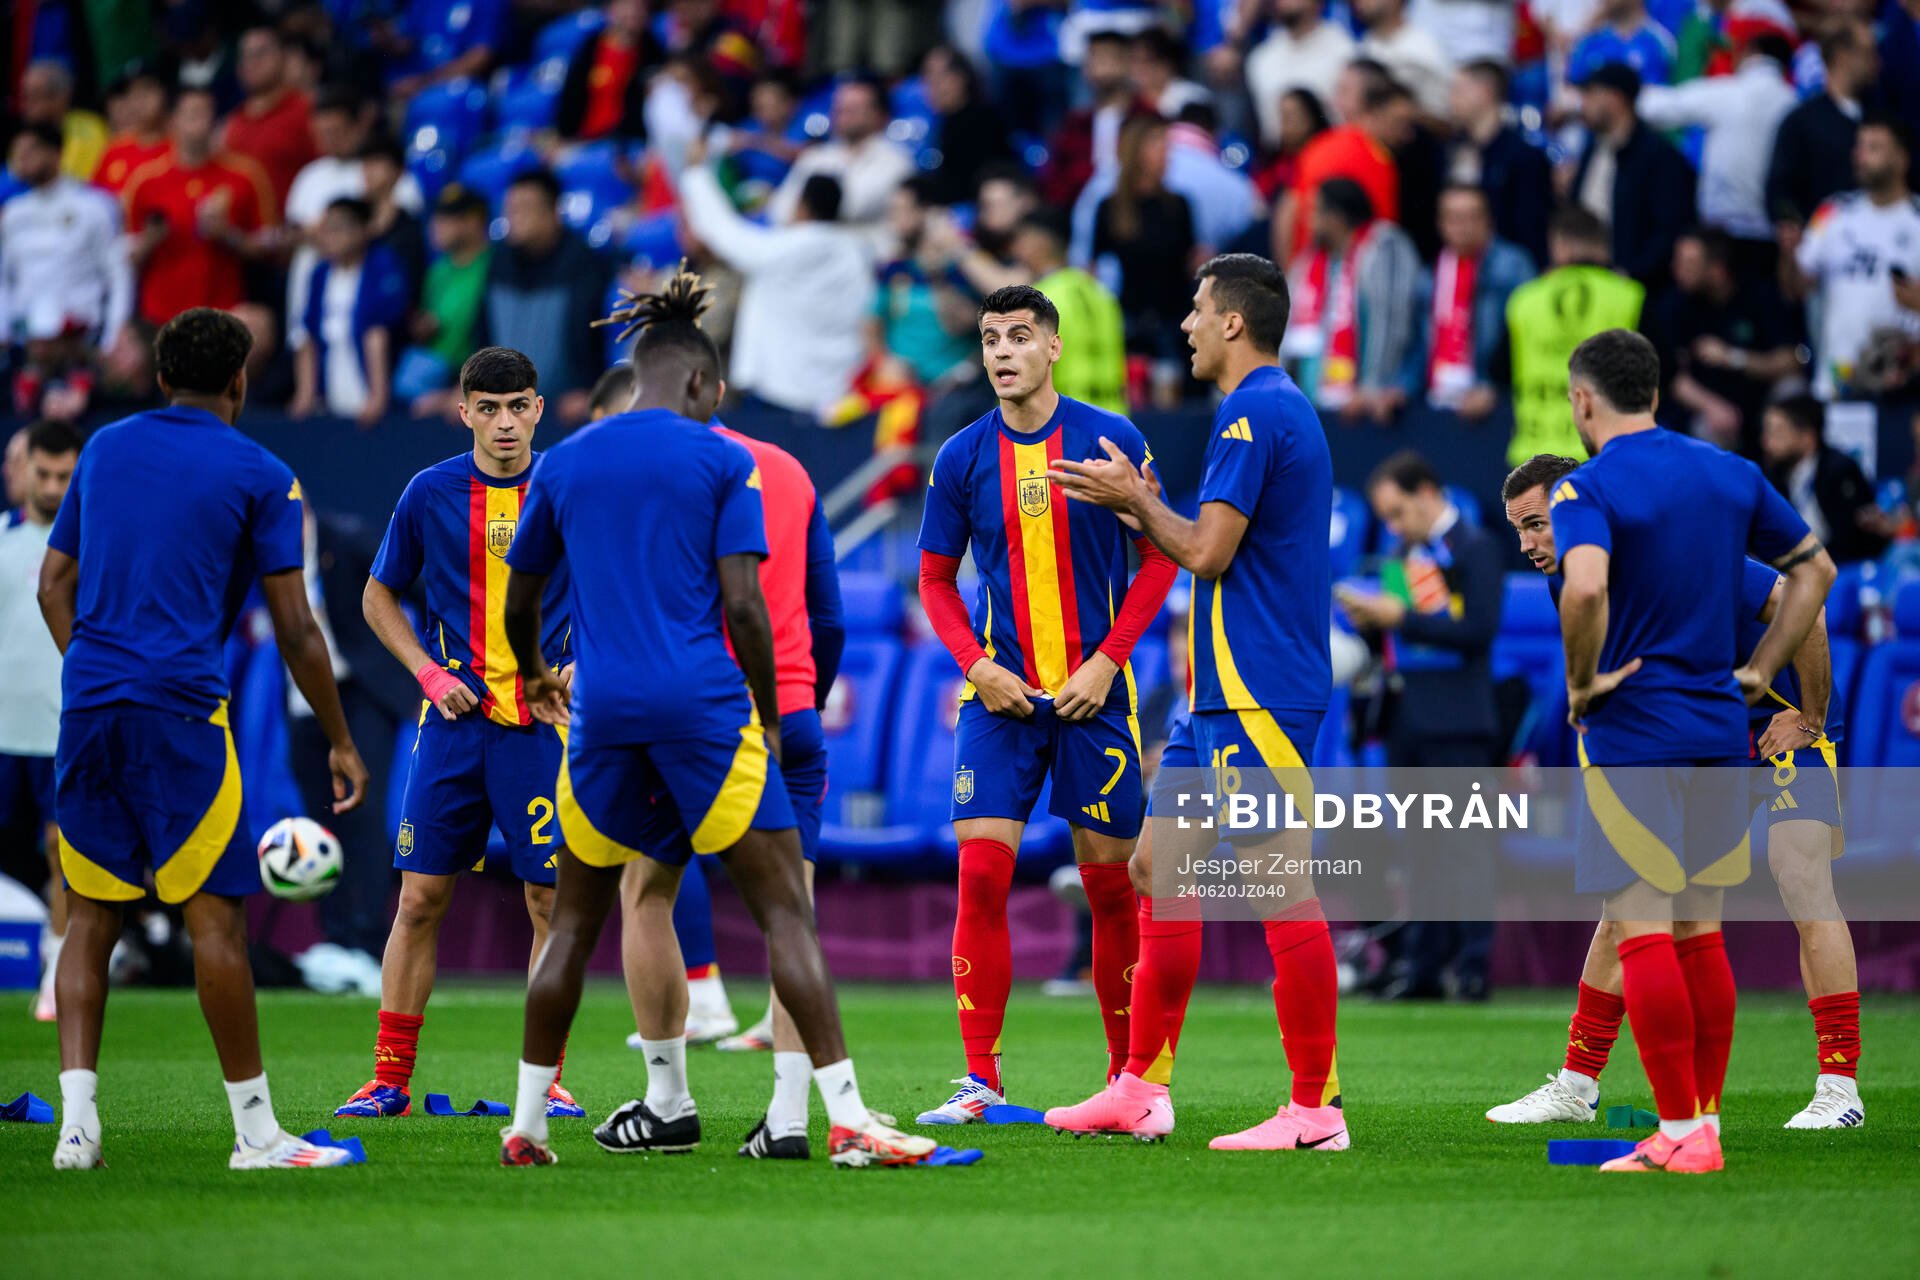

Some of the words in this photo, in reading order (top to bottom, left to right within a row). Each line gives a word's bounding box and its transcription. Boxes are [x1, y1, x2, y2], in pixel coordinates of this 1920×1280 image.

[1100, 747, 1127, 795] 7
[1212, 744, 1242, 800] 16
[1769, 750, 1797, 786] 8
